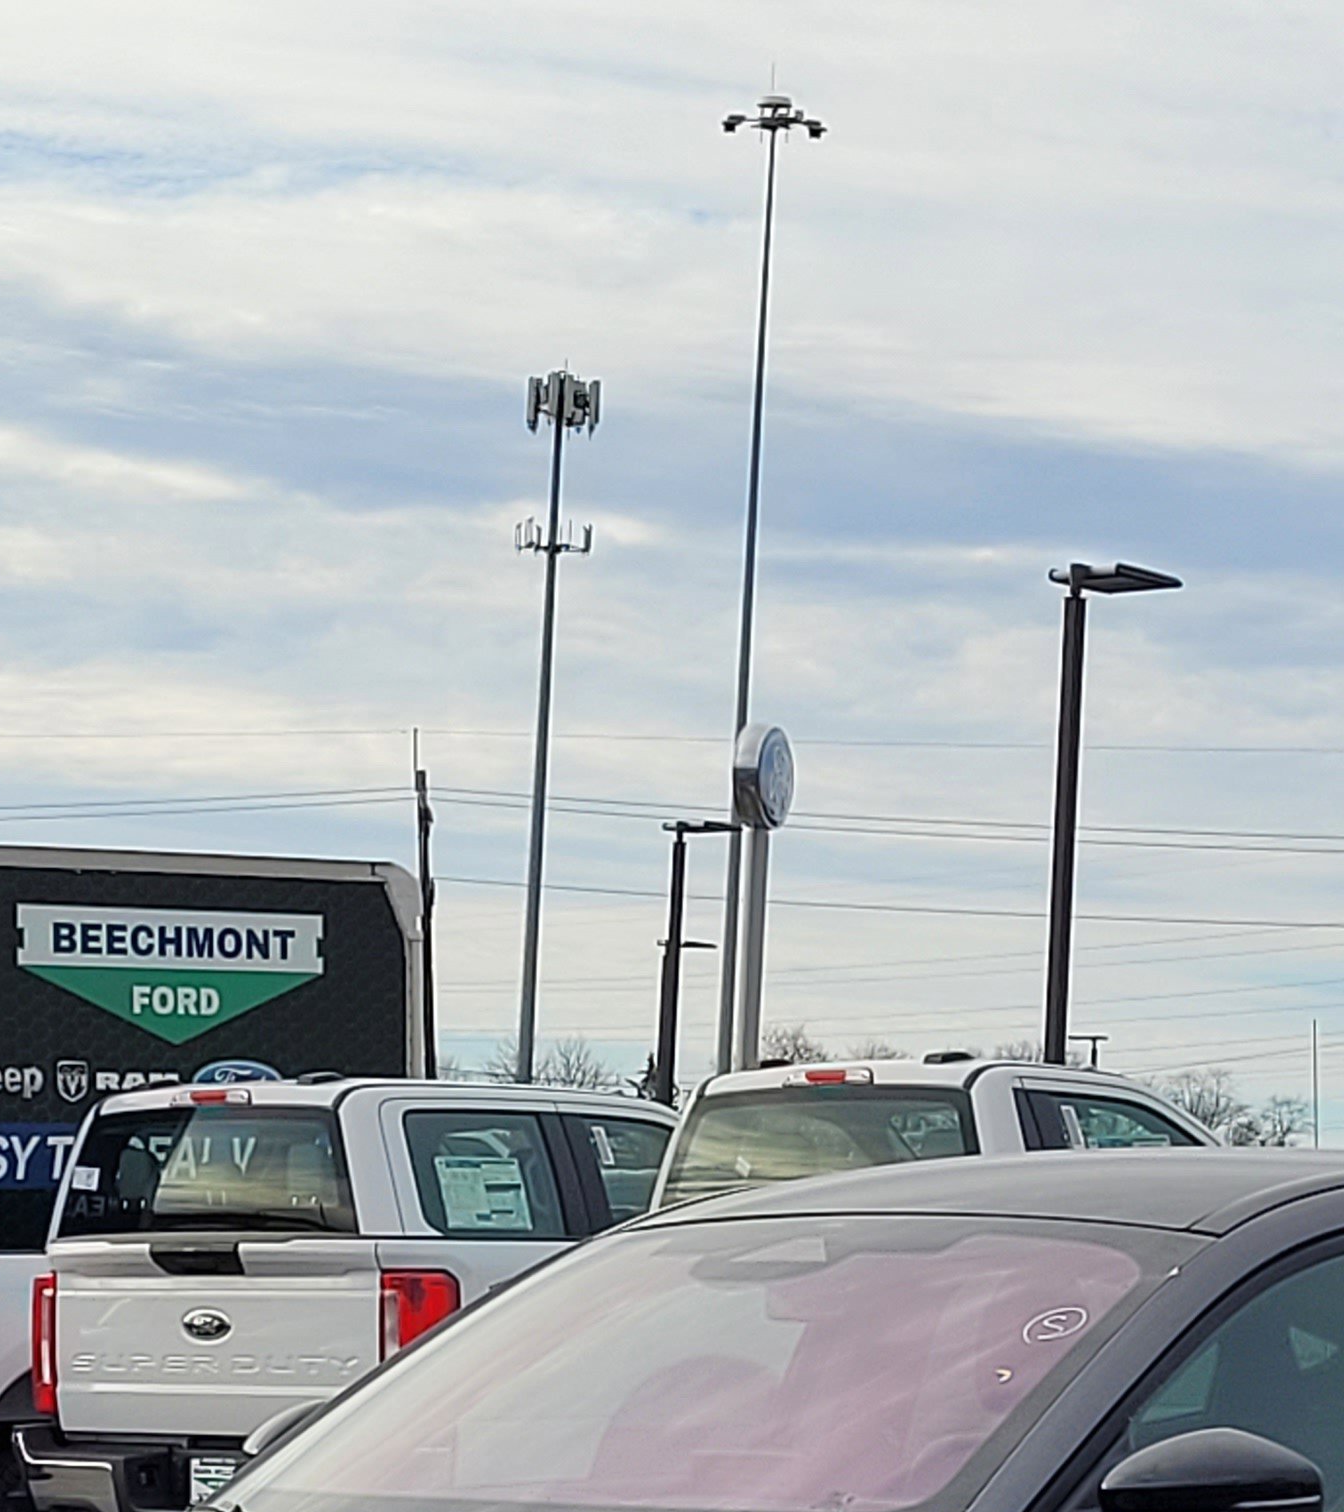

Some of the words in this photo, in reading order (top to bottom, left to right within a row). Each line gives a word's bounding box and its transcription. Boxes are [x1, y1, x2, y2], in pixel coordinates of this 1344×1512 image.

[53, 921, 296, 961] BEECHMONT
[133, 985, 220, 1016] FORD
[70, 1352, 220, 1375] SUPER
[229, 1352, 362, 1375] DUTY
